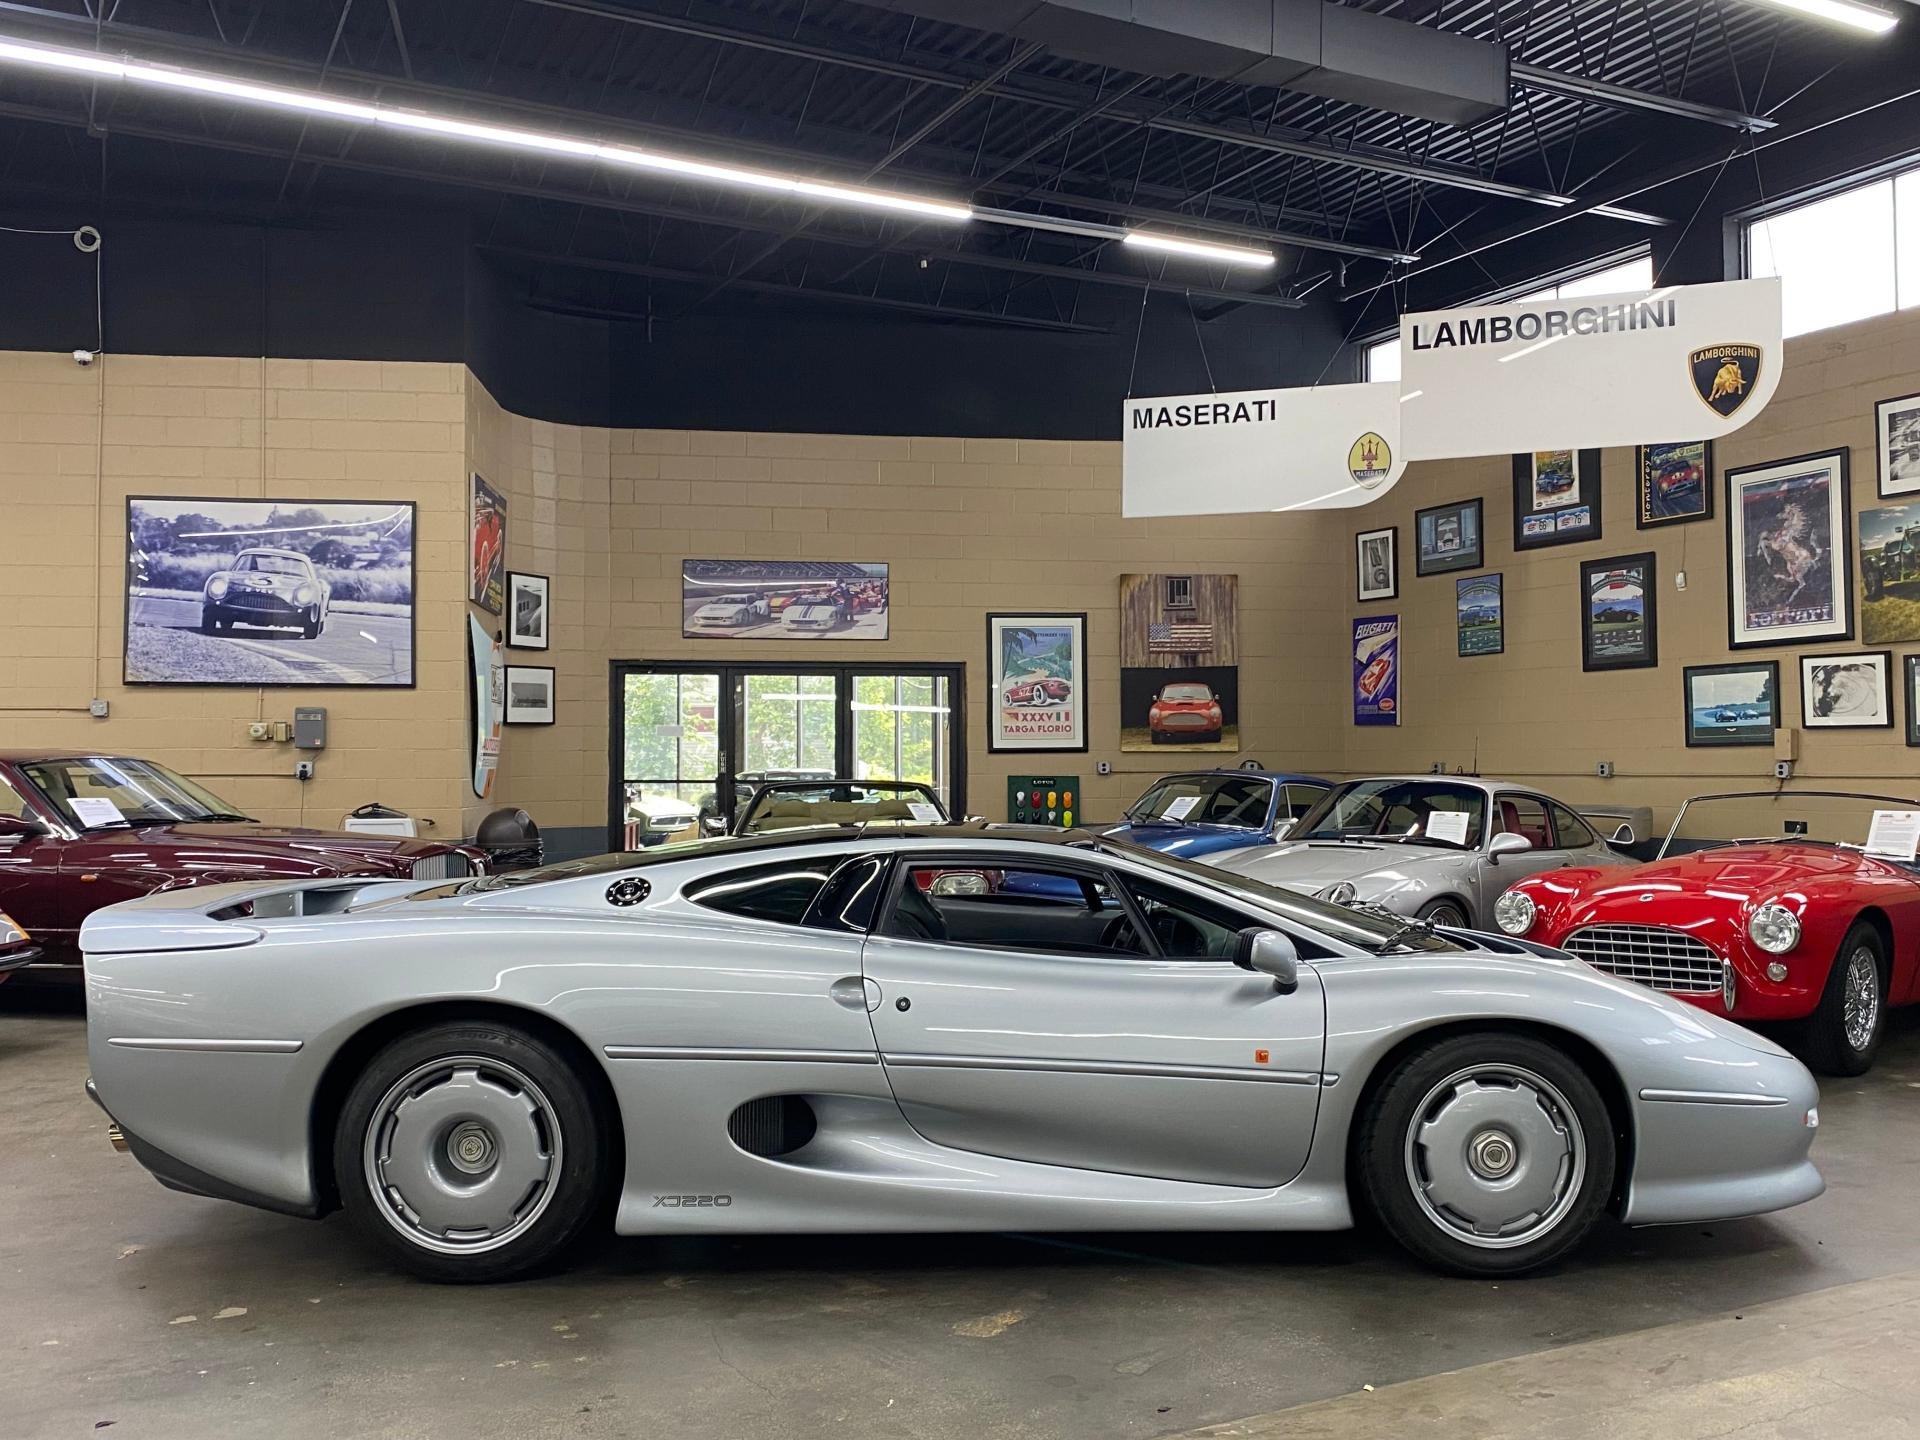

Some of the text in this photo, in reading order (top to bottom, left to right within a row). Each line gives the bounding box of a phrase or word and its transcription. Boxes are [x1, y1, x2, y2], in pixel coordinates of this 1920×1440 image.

[1412, 299, 1677, 350] LAMBORGHINI
[1693, 346, 1758, 363] LAMBORGHINI
[1132, 399, 1277, 430] MASERATI
[1355, 469, 1384, 477] MASERATI
[1644, 460, 1652, 520] Monterey
[1355, 622, 1396, 640] BUGATTI
[1021, 712, 1054, 722] XXXV
[1003, 724, 1072, 733] TARGA FLORIO
[652, 1195, 732, 1208] XJ220
